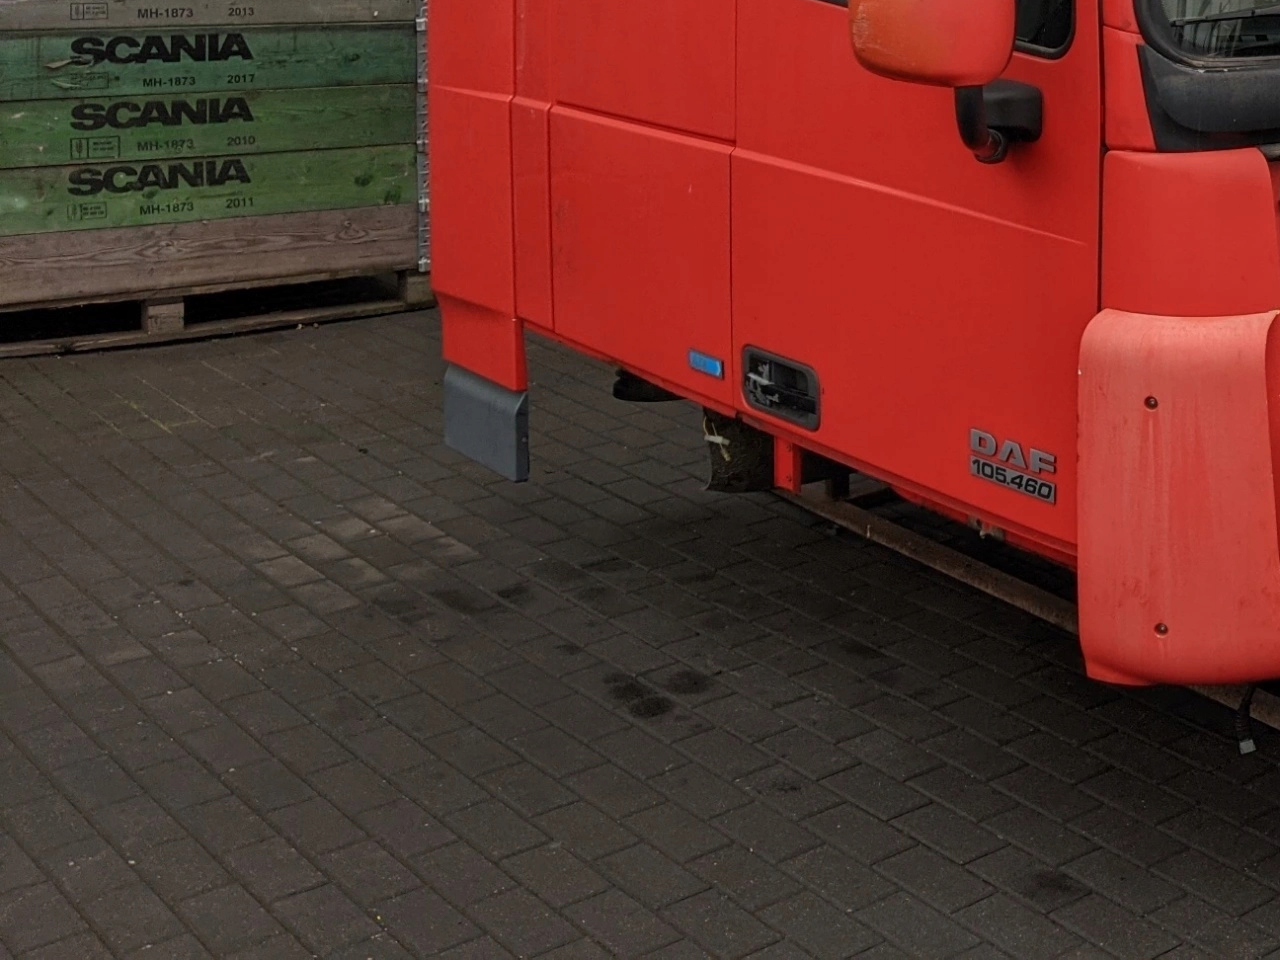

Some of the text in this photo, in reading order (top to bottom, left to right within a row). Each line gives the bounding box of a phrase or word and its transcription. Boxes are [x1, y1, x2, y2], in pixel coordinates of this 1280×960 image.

[137, 7, 255, 19] MH-1873 2013
[69, 32, 254, 65] SCANIA
[142, 74, 256, 88] MH-1873 2017
[69, 97, 255, 131] SCANIA
[137, 139, 194, 152] MH-1873
[67, 158, 252, 196] SCANIA
[139, 198, 255, 216] MH-1873 2011
[970, 428, 1057, 474] DAF
[971, 458, 1053, 500] 105.460
